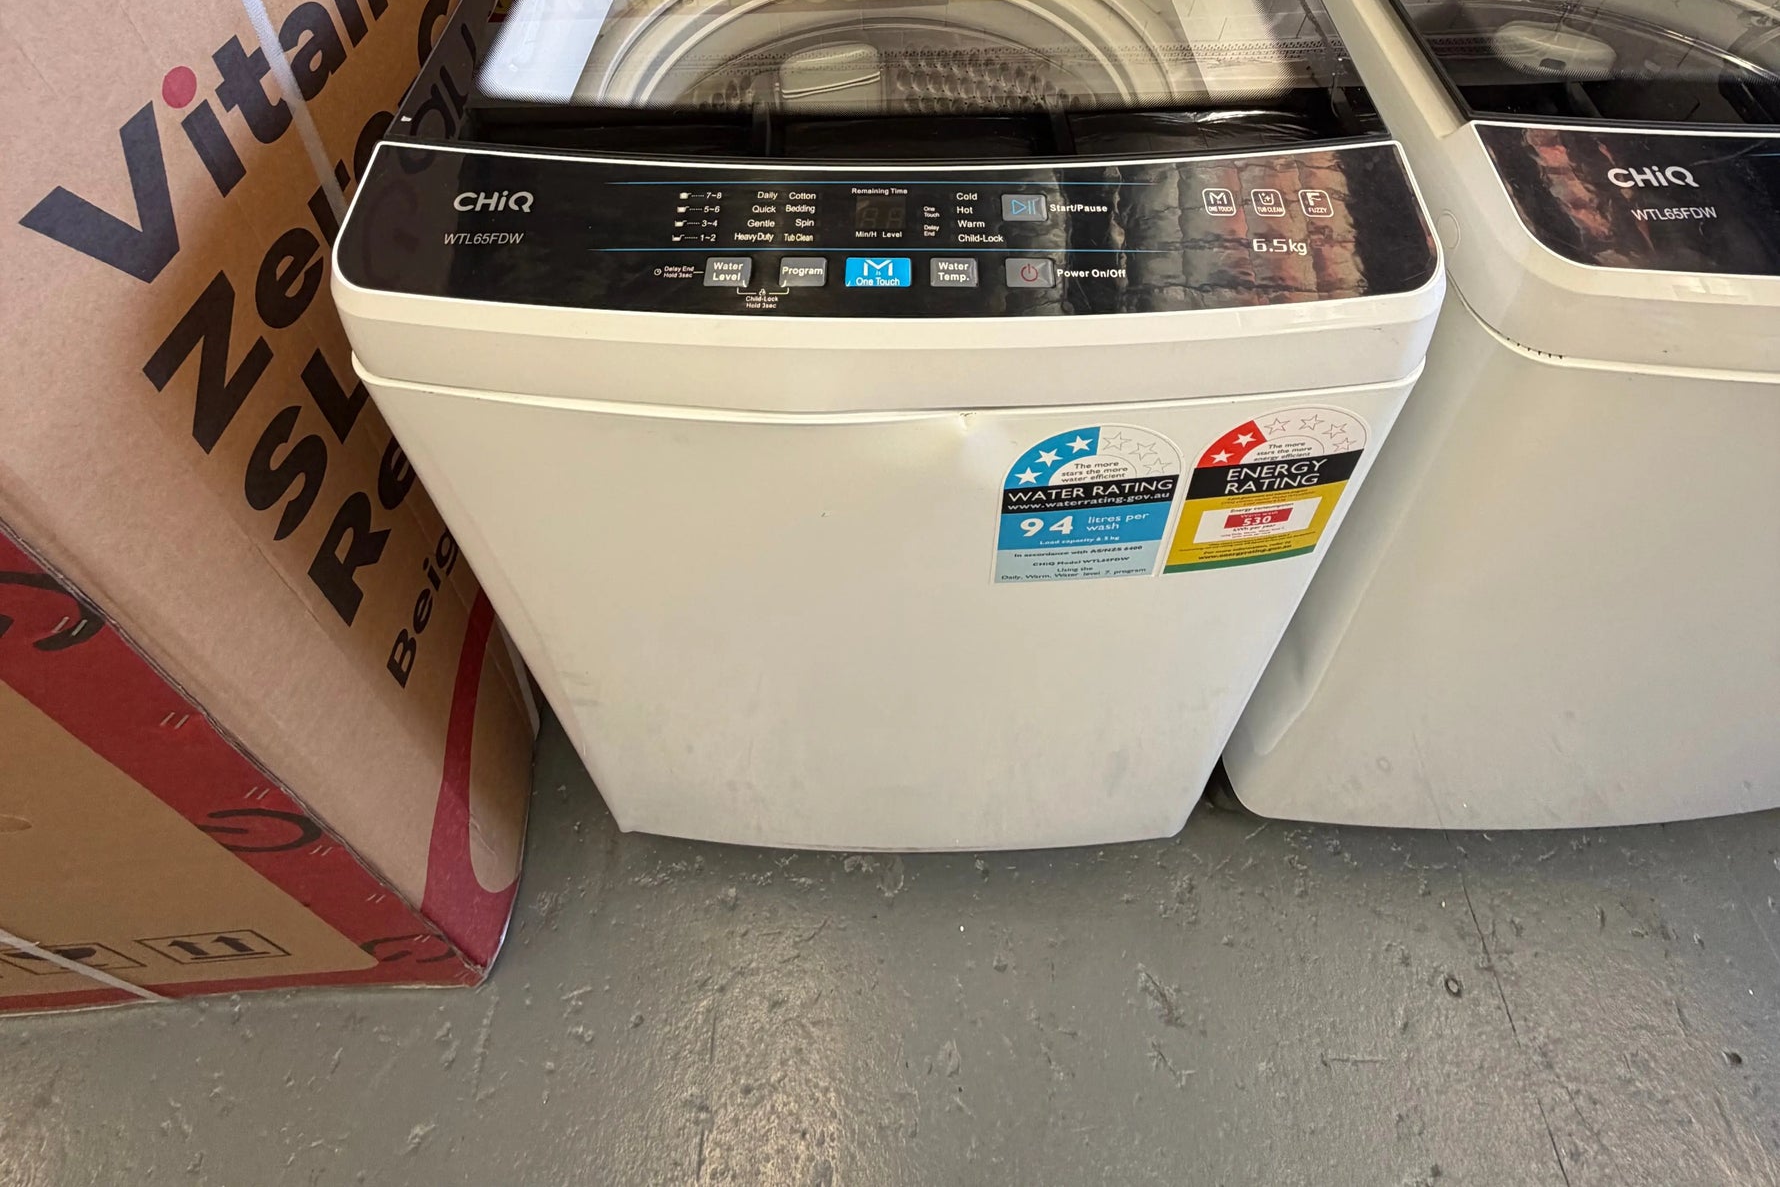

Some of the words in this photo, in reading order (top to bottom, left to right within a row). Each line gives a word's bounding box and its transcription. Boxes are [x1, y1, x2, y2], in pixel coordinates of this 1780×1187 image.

[1607, 165, 1700, 188] CHiQ
[851, 187, 889, 195] Remaining
[890, 187, 908, 195] Time
[757, 192, 778, 201] Daily
[788, 192, 817, 200] Cotton
[956, 192, 978, 201] Cold
[453, 190, 534, 213] CHiQ
[752, 205, 777, 213] Quick
[785, 205, 816, 214] Bedding
[956, 206, 973, 214] Hot
[1049, 204, 1108, 213] Start/Pause
[1631, 206, 1718, 222] WTL65FDW
[747, 219, 775, 227] Gentle
[795, 219, 815, 228] Spin
[957, 220, 986, 228] Warm
[444, 233, 524, 245] WTL65FDW
[958, 234, 1004, 243] Child-Lock
[1252, 238, 1308, 256] 6.5kg
[713, 262, 744, 271] Water
[938, 261, 969, 271] Water
[782, 266, 823, 276] Program
[1057, 269, 1090, 278] Power
[1091, 269, 1127, 278] On/Off
[713, 272, 741, 281] Level
[938, 272, 970, 282] Temp.
[855, 277, 874, 286] One
[875, 277, 900, 286] Touch
[1074, 462, 1093, 470] The
[1226, 458, 1329, 481] ENERGY
[1090, 472, 1126, 481] efficient
[1224, 473, 1321, 494] RATING
[1008, 487, 1085, 503] WATER
[1092, 479, 1174, 497] RATING
[1007, 491, 1170, 511] www.waterrating.gov.au
[1088, 515, 1122, 524] litres
[1125, 513, 1150, 523] per
[1020, 515, 1074, 537] 94
[1086, 522, 1120, 532] wash
[1061, 537, 1095, 545] capacity
